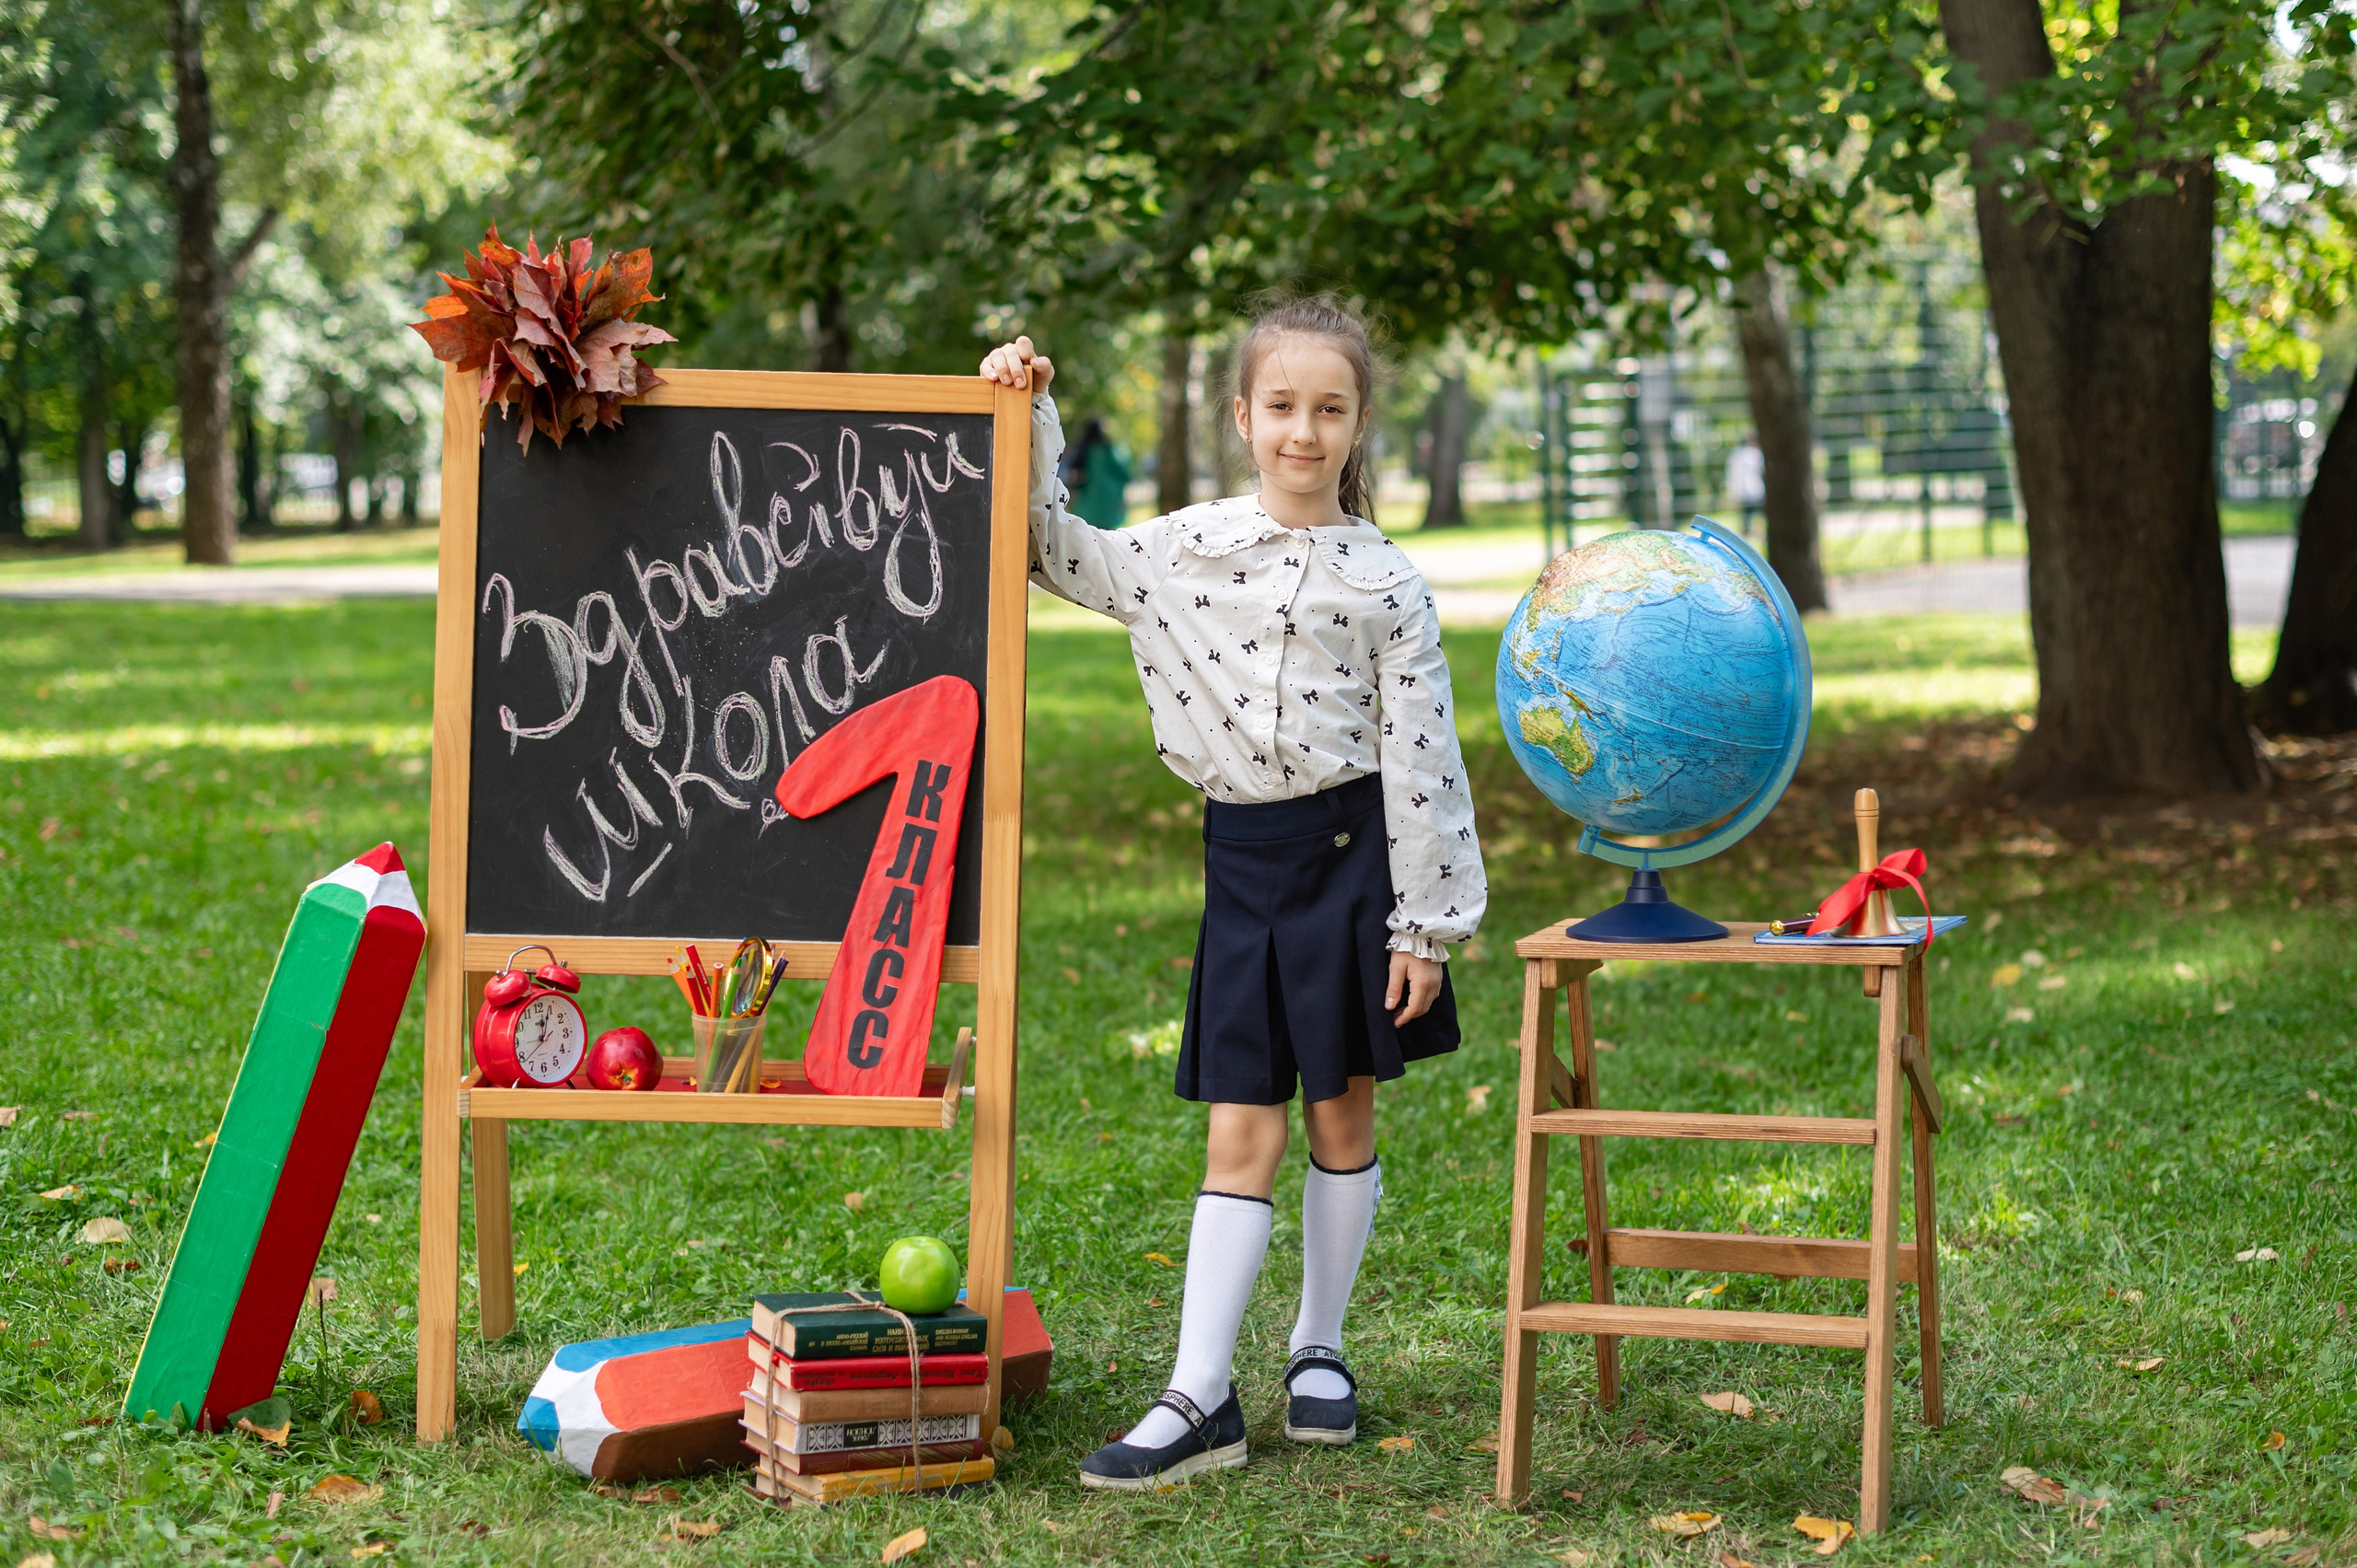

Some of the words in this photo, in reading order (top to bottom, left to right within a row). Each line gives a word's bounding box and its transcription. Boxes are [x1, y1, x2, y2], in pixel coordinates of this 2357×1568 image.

[846, 760, 954, 1070] КЛАСС
[524, 1008, 531, 1019] 11
[534, 1002, 543, 1014] 12
[557, 1013, 564, 1024] 2
[563, 1028, 569, 1039] 3
[559, 1043, 565, 1054] 4
[518, 1051, 526, 1063] 8
[552, 1055, 559, 1066] 5
[528, 1061, 534, 1072] 7
[540, 1062, 547, 1073] 6
